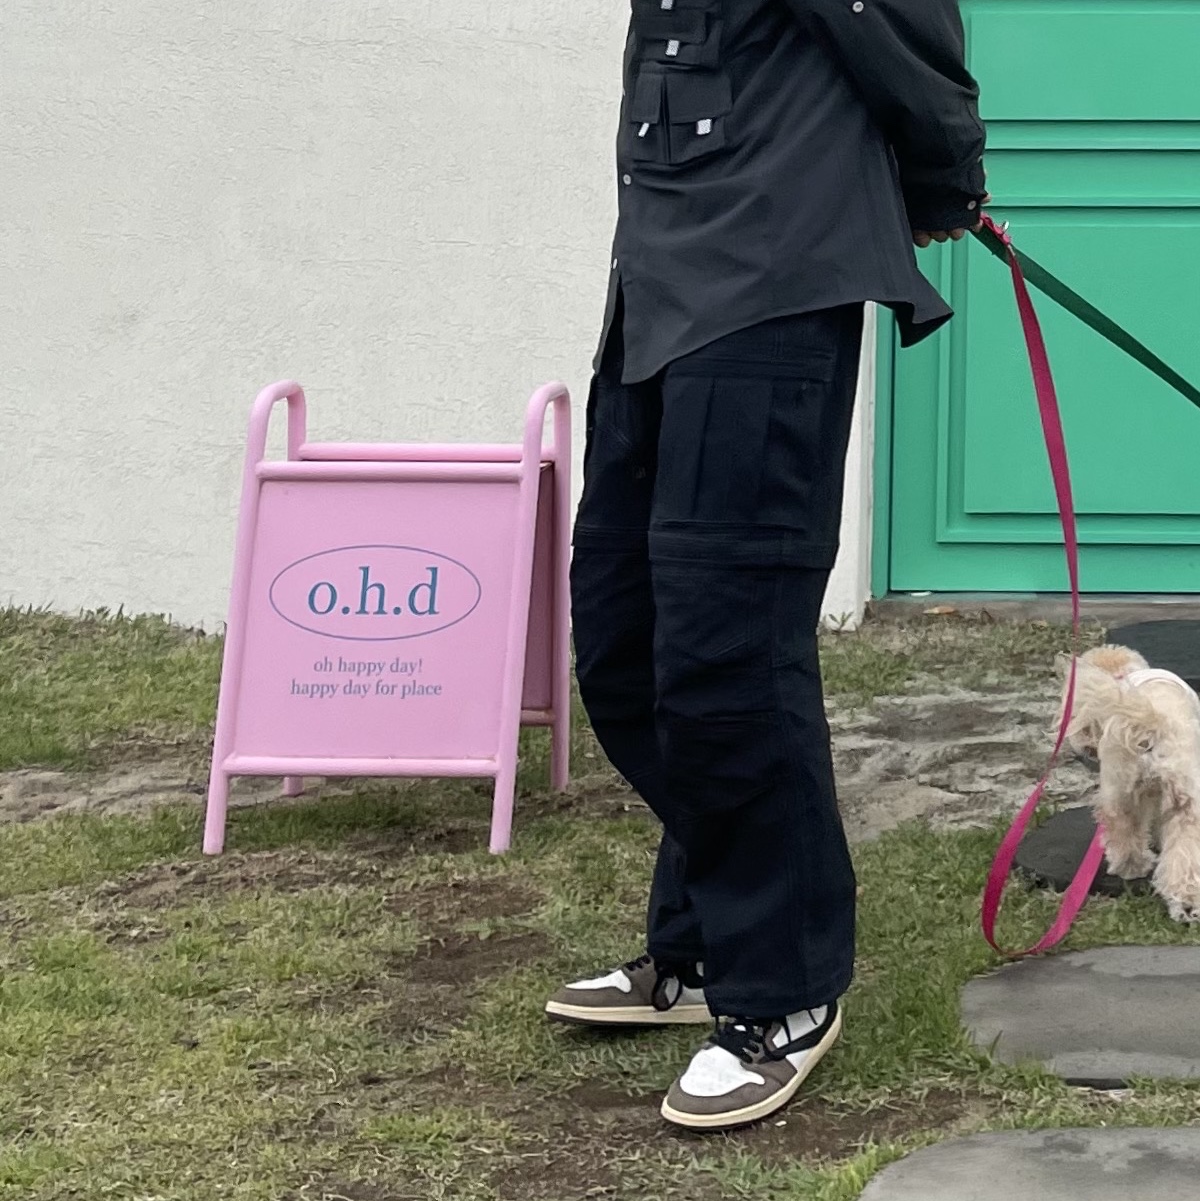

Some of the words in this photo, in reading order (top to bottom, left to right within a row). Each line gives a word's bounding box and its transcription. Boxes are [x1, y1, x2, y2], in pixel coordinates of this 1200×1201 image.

[307, 565, 440, 617] o.h.d
[313, 656, 333, 673] oh
[338, 656, 386, 677] happy
[389, 657, 423, 677] day!
[290, 678, 339, 699] happy
[342, 679, 372, 699] day
[374, 679, 398, 696] for
[400, 679, 443, 700] place
